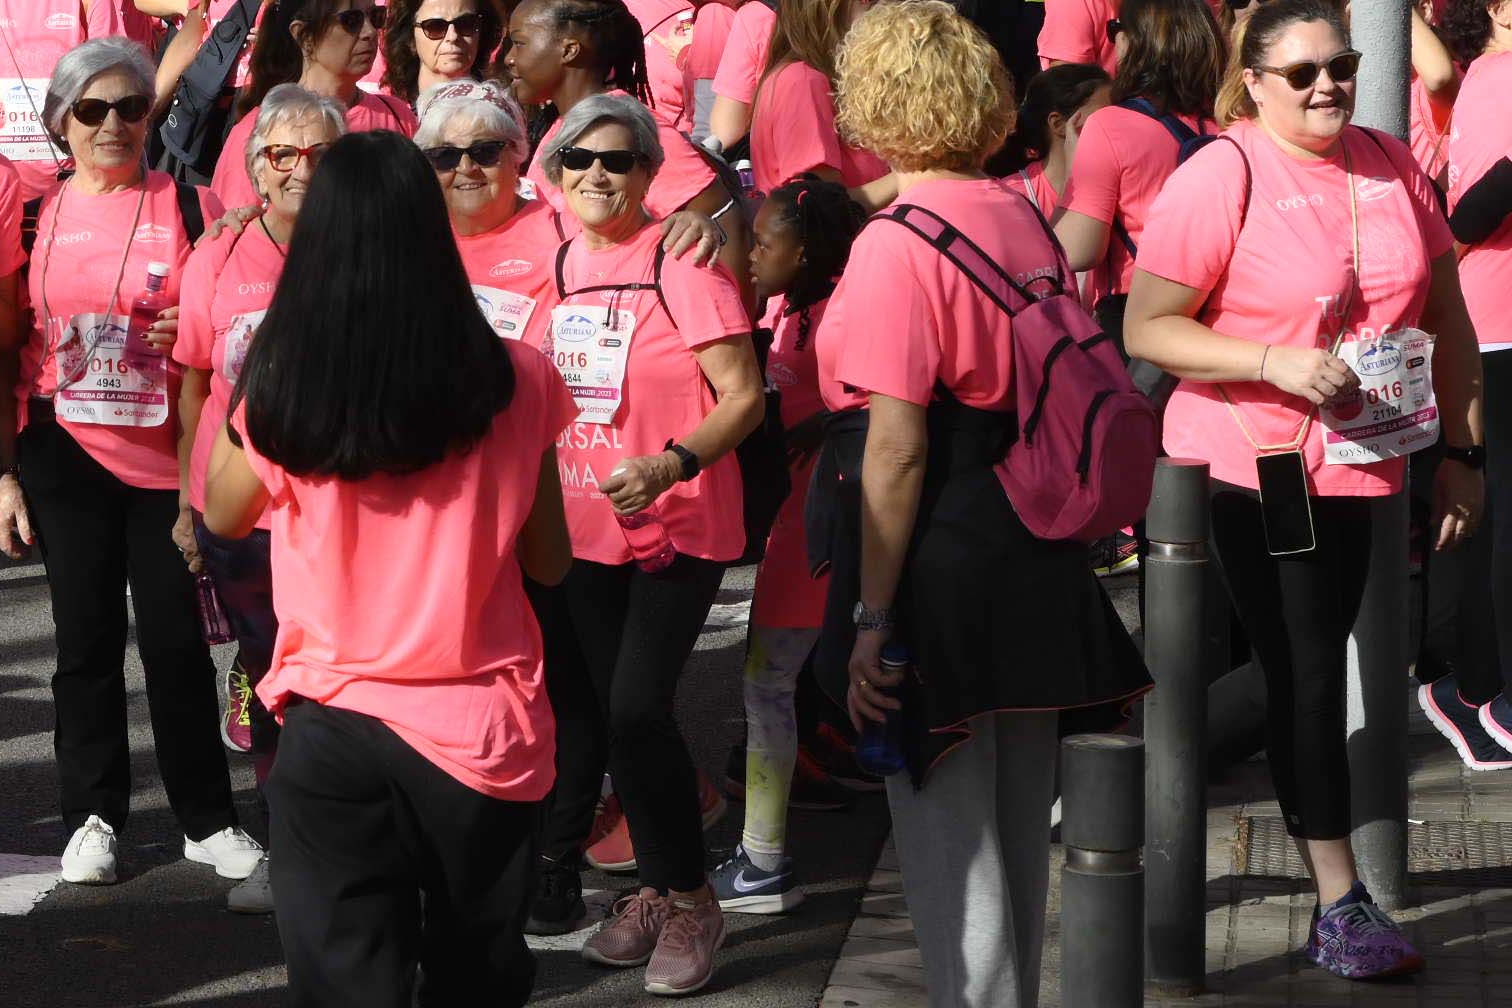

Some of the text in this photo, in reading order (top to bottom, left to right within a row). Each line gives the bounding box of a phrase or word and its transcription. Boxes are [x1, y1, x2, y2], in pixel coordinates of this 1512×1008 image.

[91, 358, 128, 373] 016
[557, 352, 587, 368] 016
[96, 378, 121, 388] 4943
[1367, 381, 1403, 404] 016
[557, 424, 623, 449] RSAL
[1339, 443, 1380, 457] OYSHO
